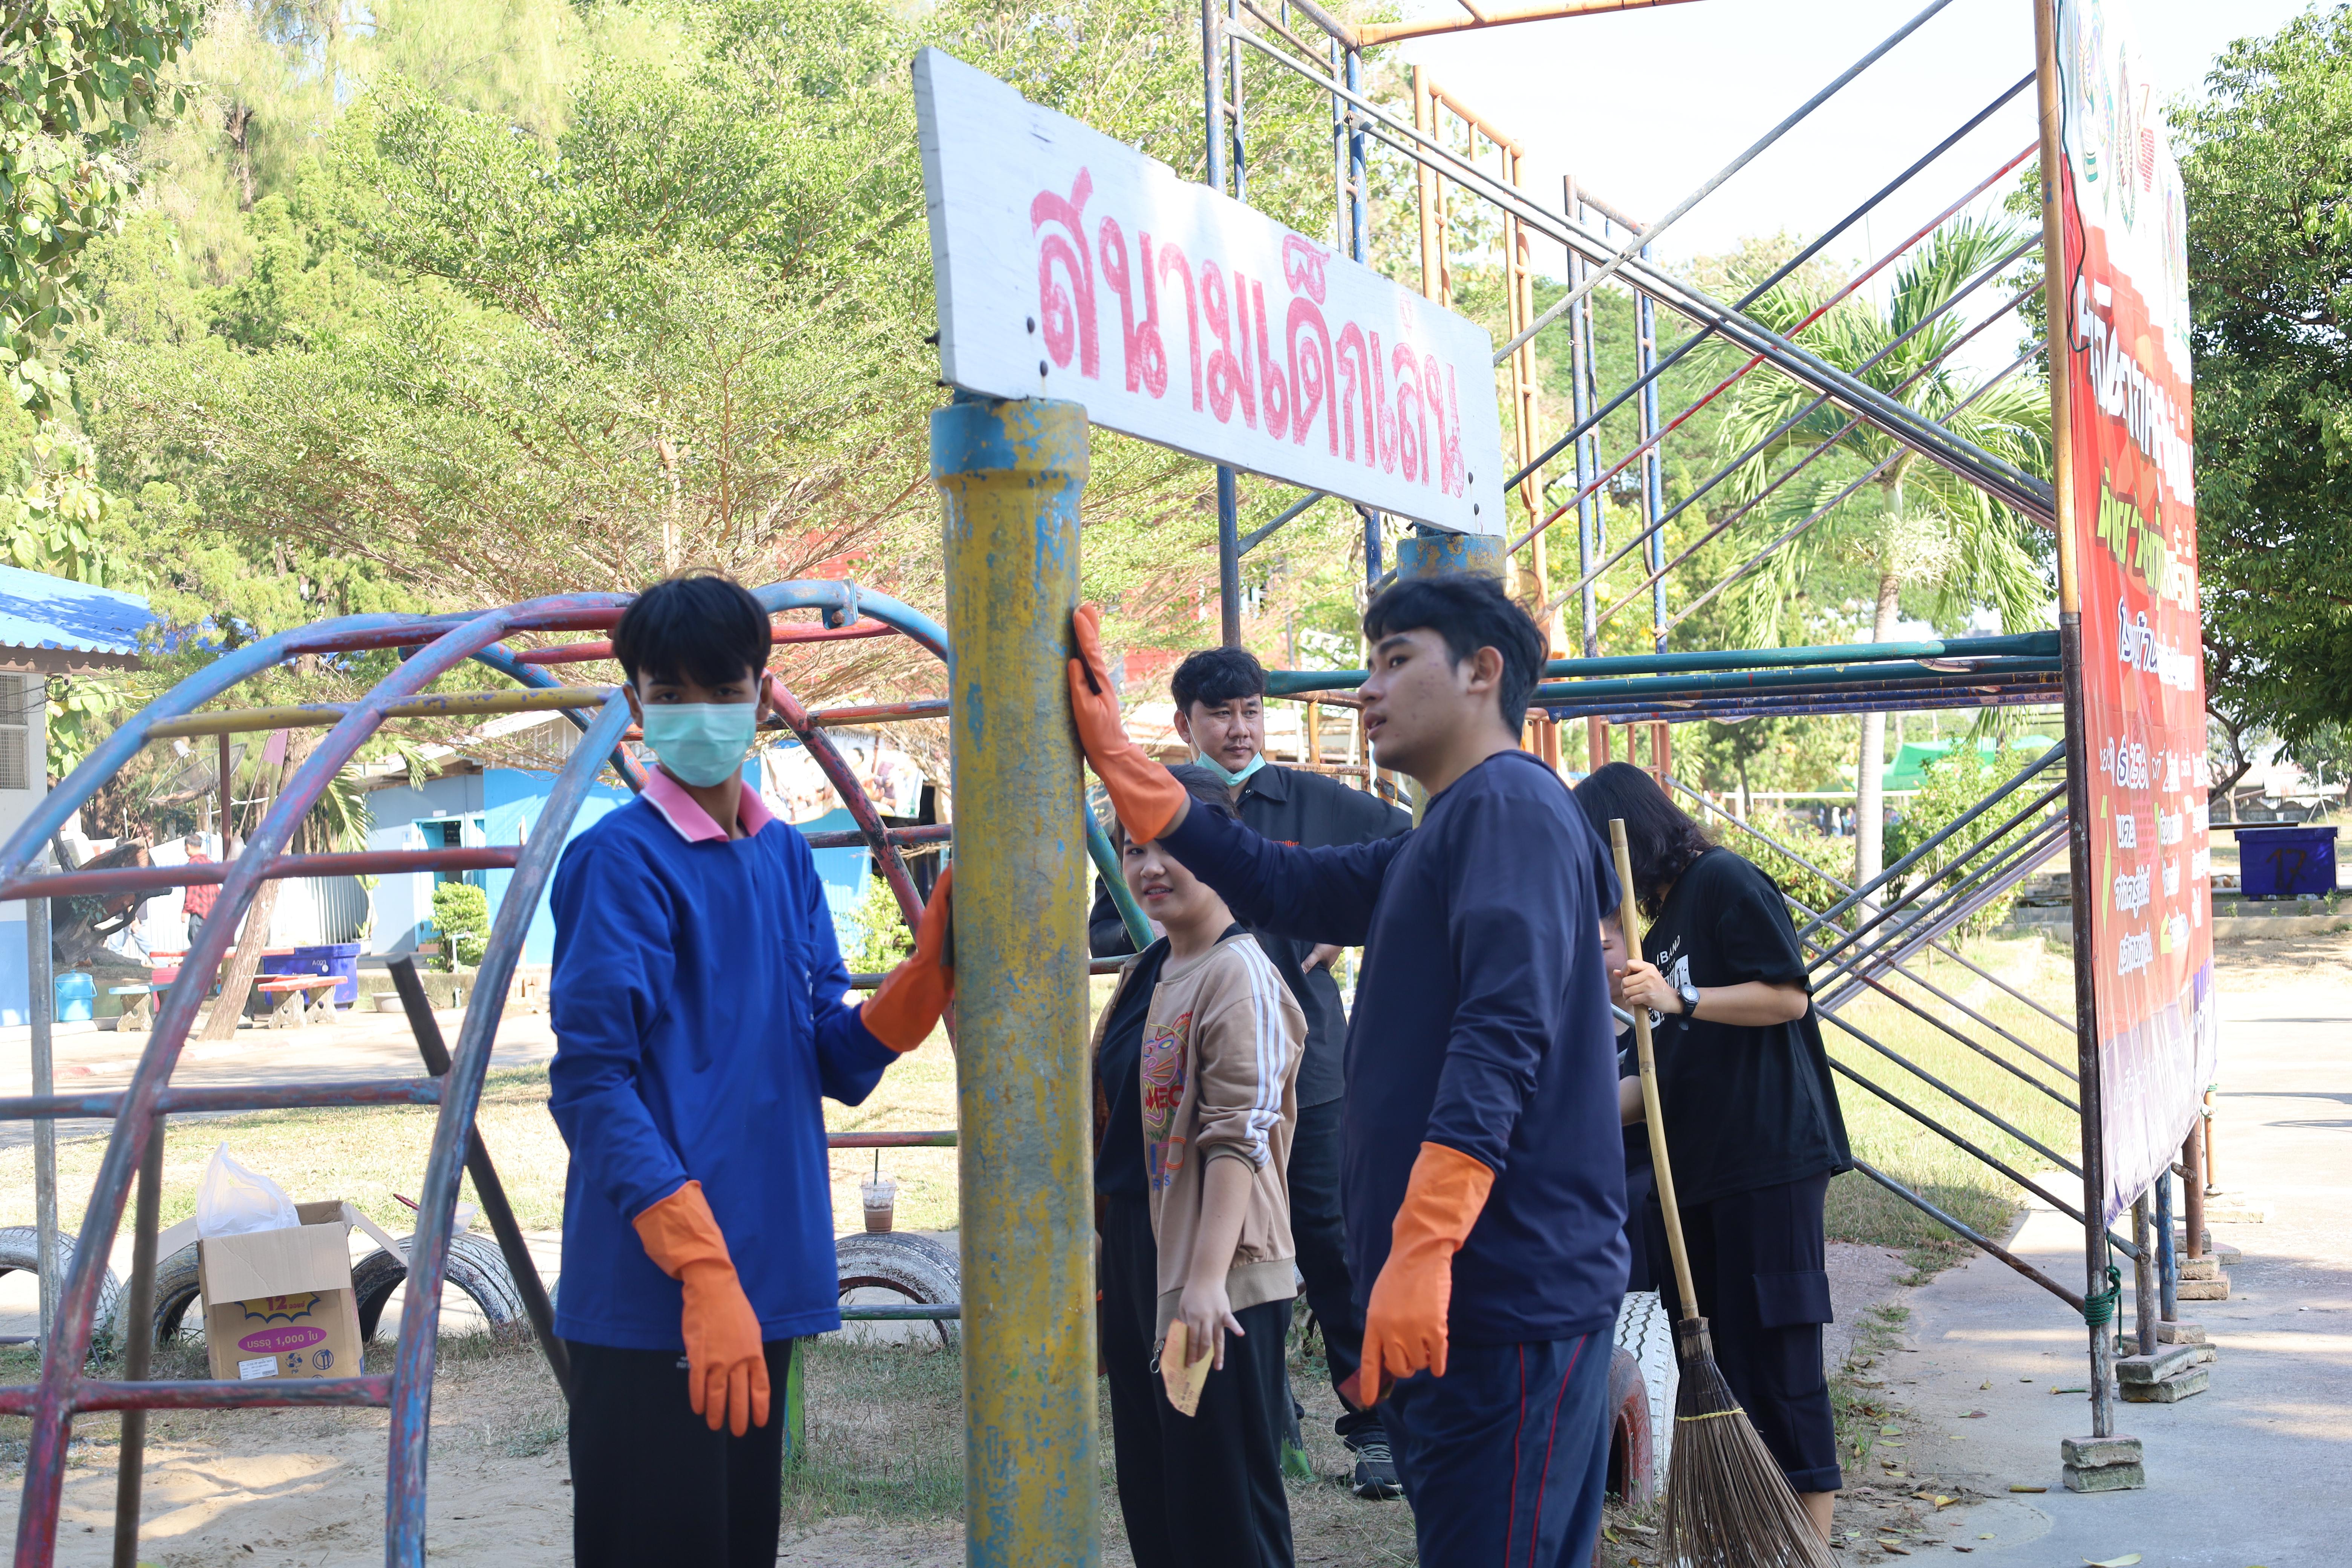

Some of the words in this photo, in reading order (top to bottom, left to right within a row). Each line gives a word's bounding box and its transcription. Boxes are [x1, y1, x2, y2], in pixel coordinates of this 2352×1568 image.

[1030, 166, 1465, 498] สนามเด็กเล่น
[266, 1295, 287, 1311] 12
[247, 1339, 271, 1348] บรรจุ
[276, 1334, 304, 1346] 1,000
[307, 1330, 318, 1341] ใบ
